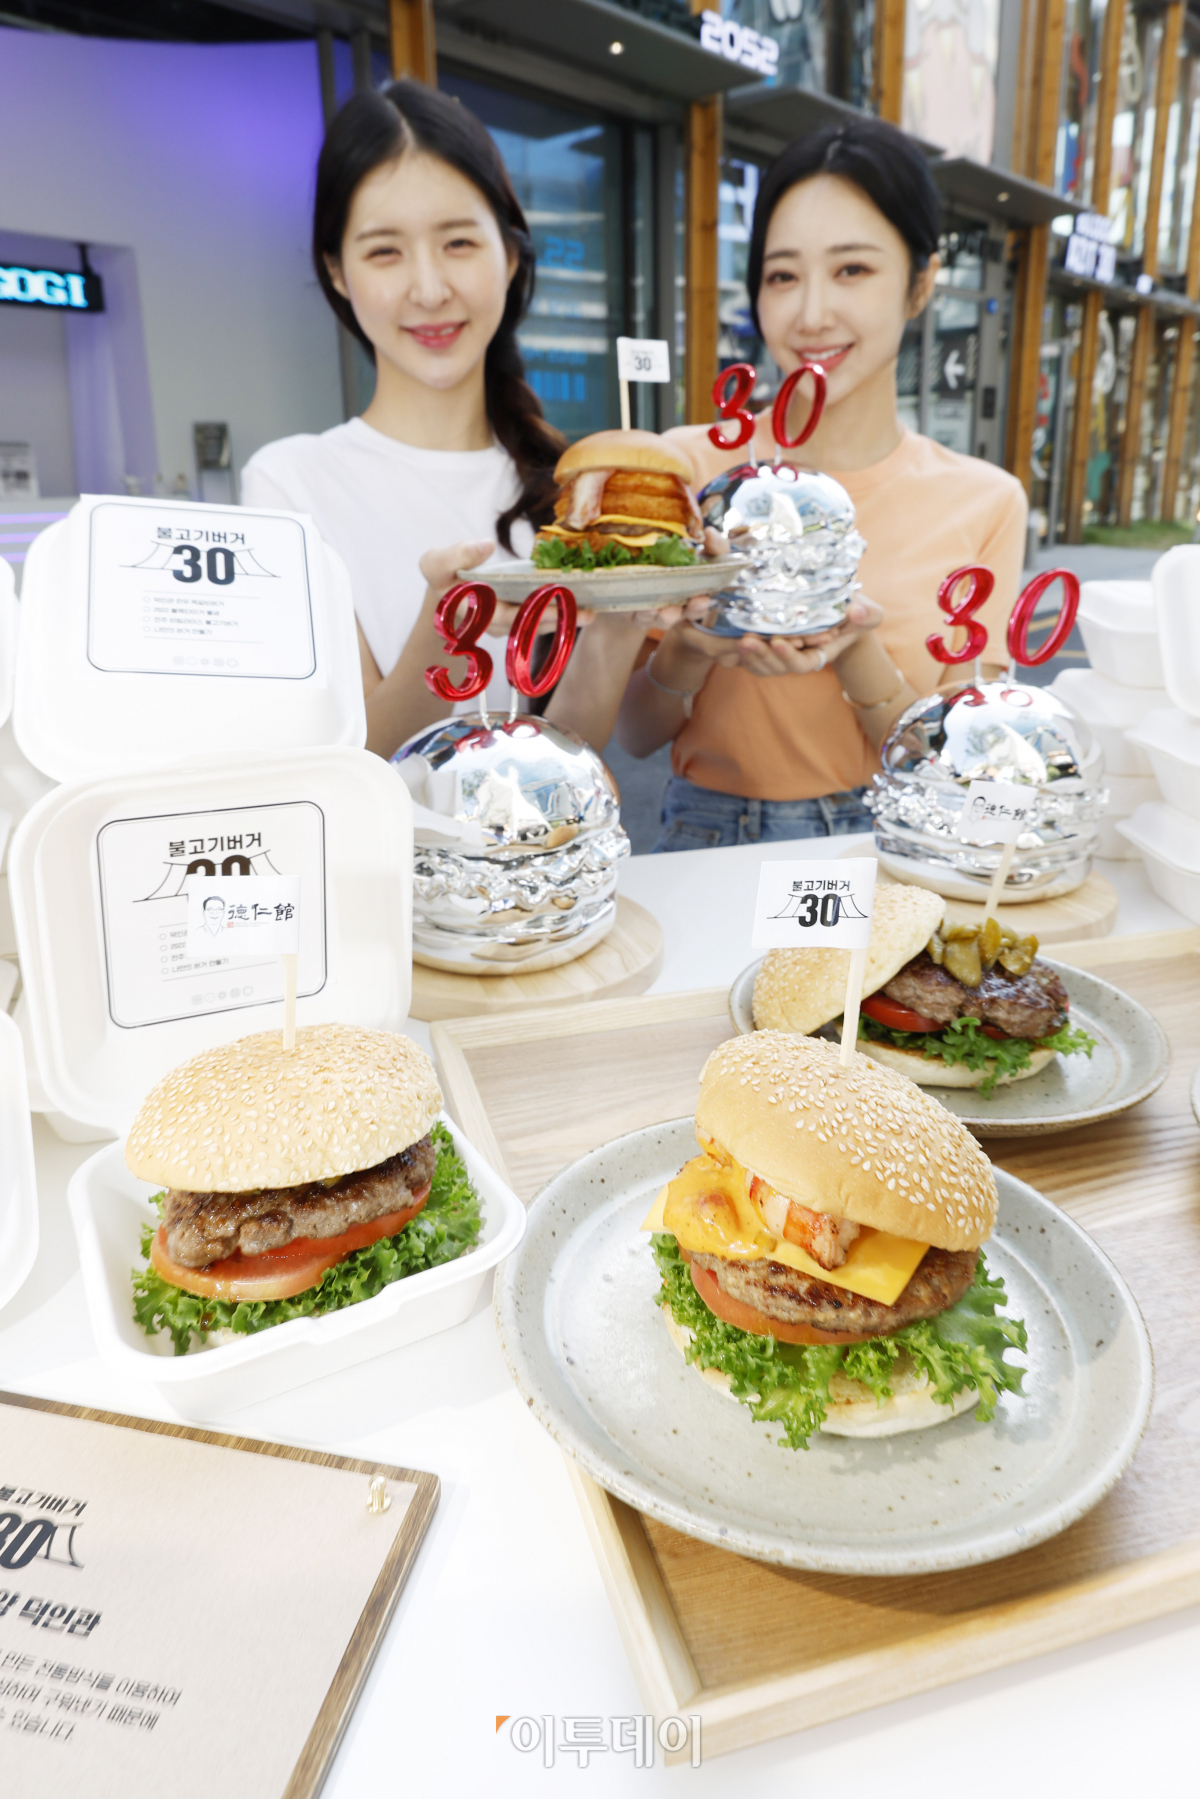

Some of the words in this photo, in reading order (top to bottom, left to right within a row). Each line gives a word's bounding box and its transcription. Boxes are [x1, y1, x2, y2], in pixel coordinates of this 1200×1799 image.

[700, 8, 779, 76] 2052
[634, 355, 652, 371] 30
[707, 362, 827, 450] 30
[157, 526, 246, 545] 불고기버거
[172, 544, 236, 586] 30
[926, 564, 1081, 668] 30
[424, 580, 578, 702] 30
[168, 831, 262, 858] 불고기버거
[792, 880, 851, 892] 불고기버거
[798, 893, 842, 928] 30
[19, 1595, 104, 1638] 덕인관
